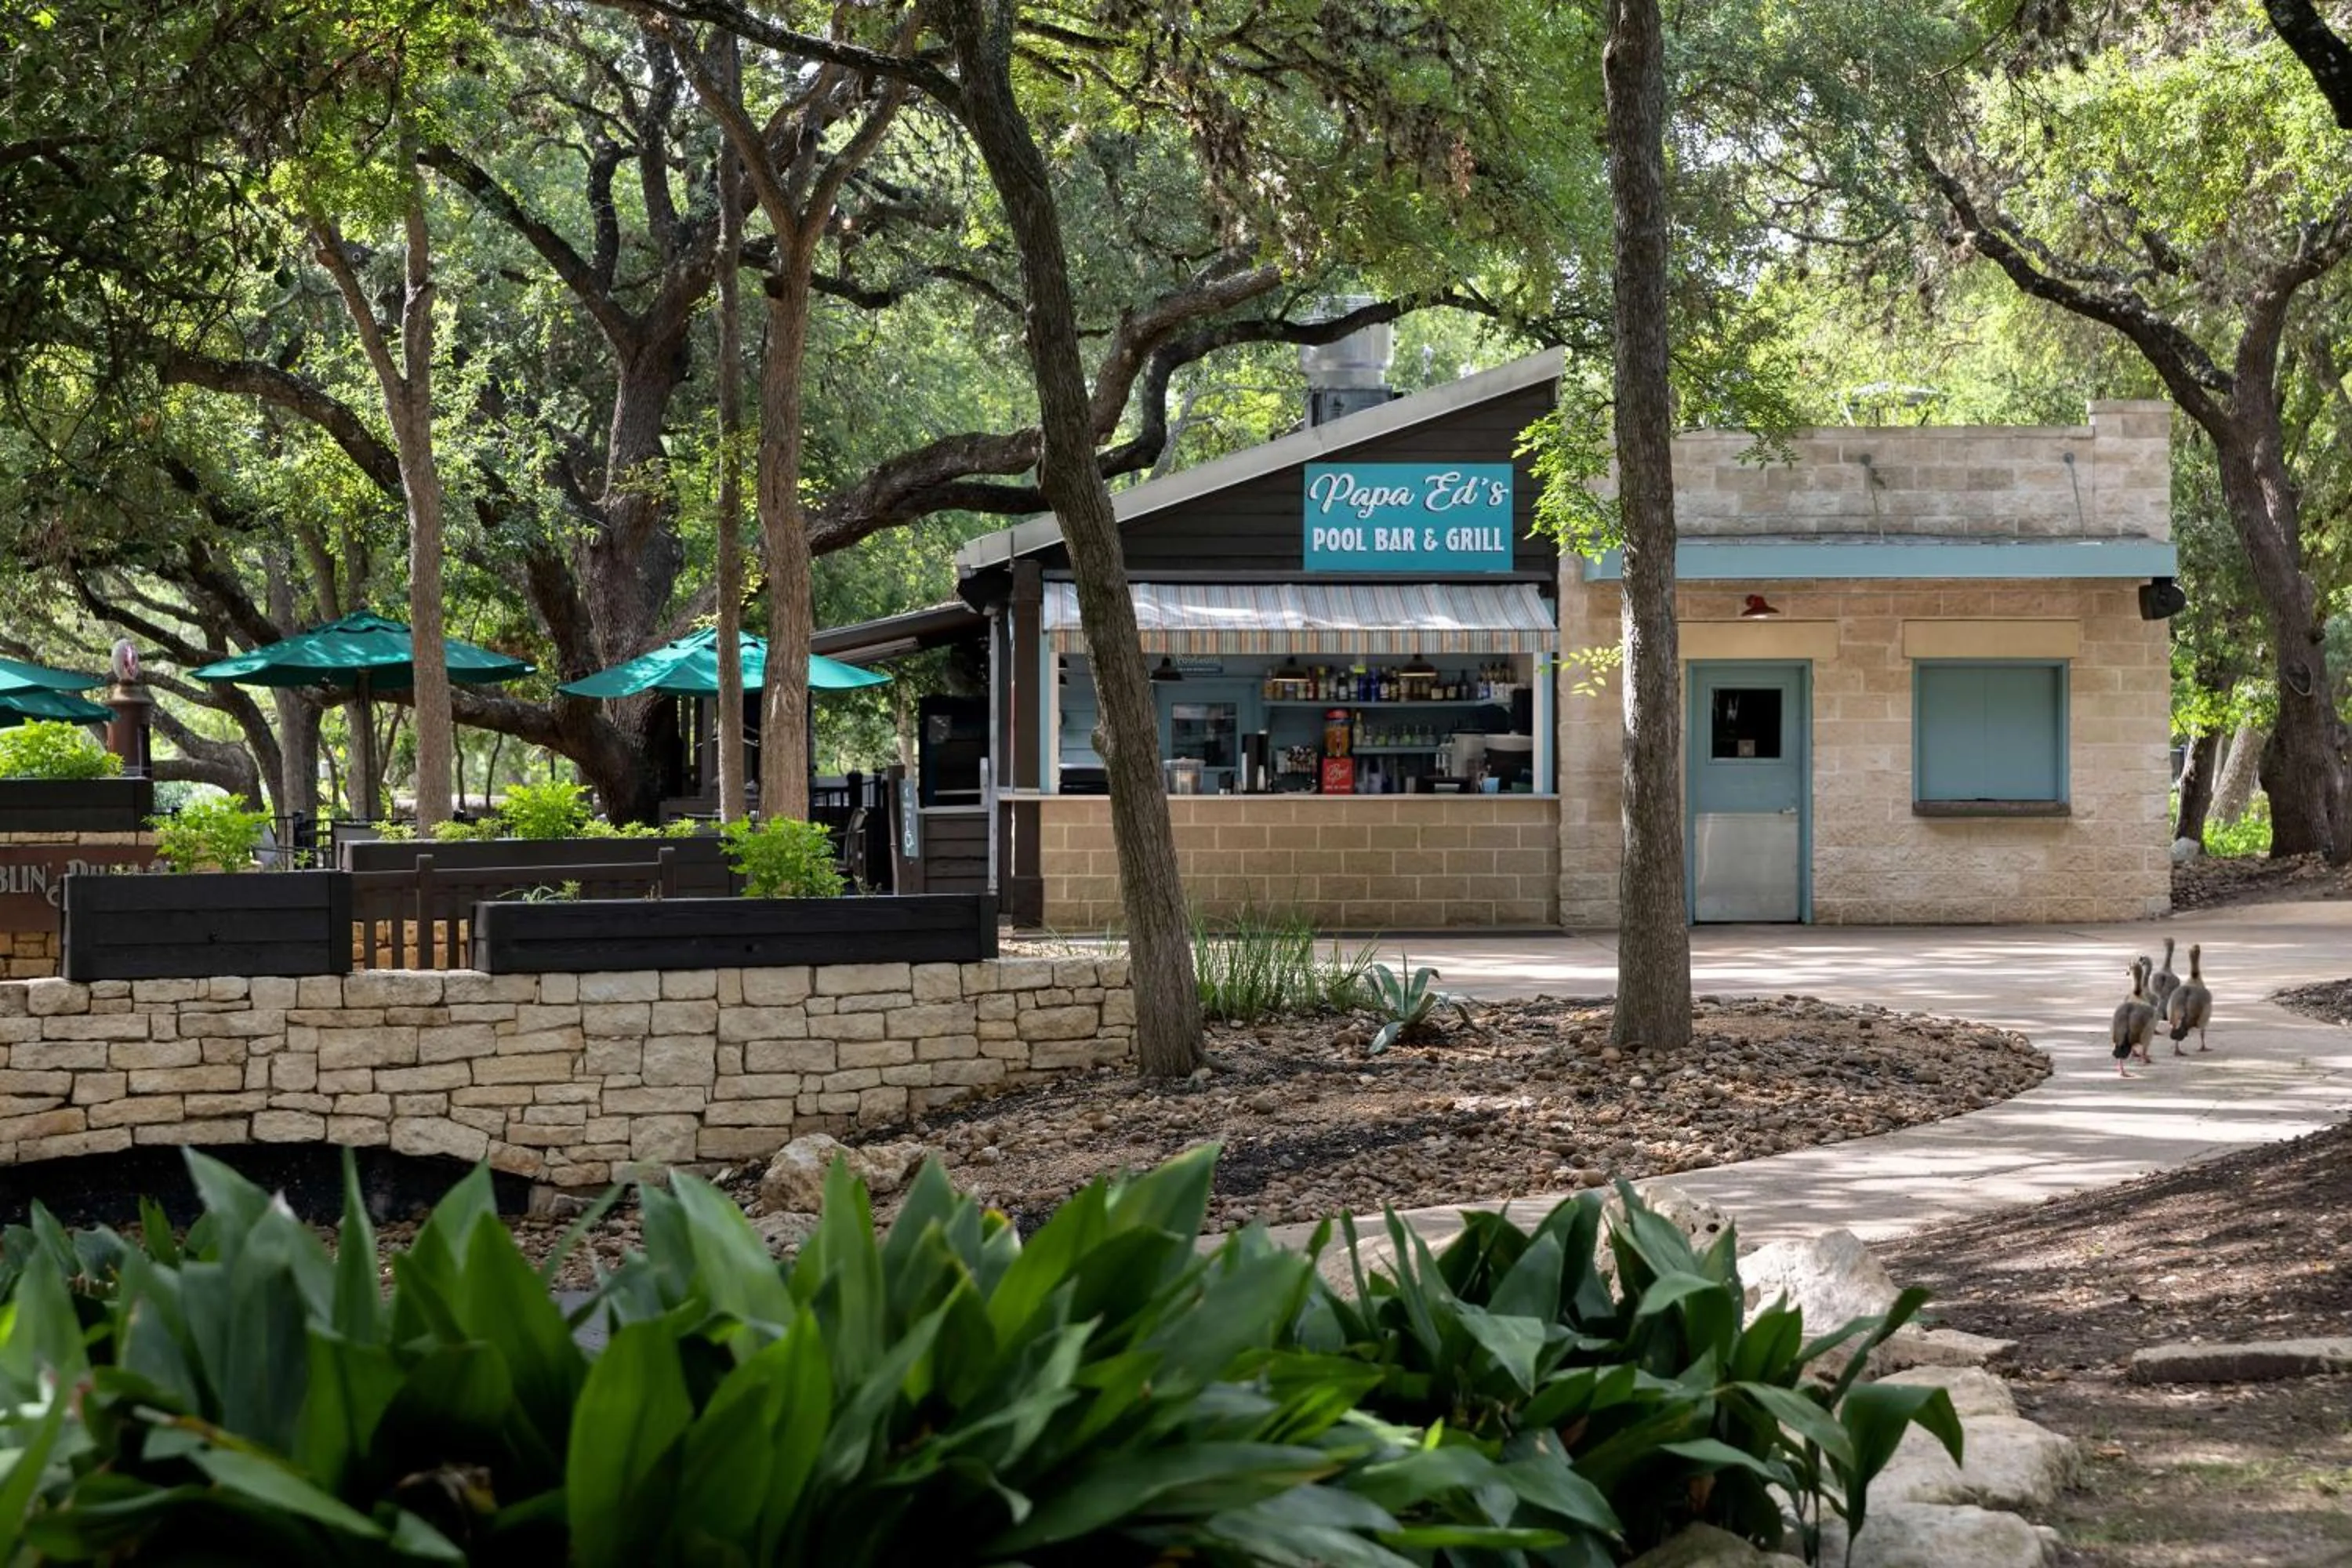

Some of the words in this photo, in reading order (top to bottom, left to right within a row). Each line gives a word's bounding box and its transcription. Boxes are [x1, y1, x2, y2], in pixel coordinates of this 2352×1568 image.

[1308, 473, 1414, 518] Papa
[1424, 471, 1508, 511] Ed's
[1313, 527, 1367, 551] POOL
[1374, 527, 1416, 551] BAR
[1423, 528, 1438, 551] &
[1445, 527, 1504, 551] GRILL
